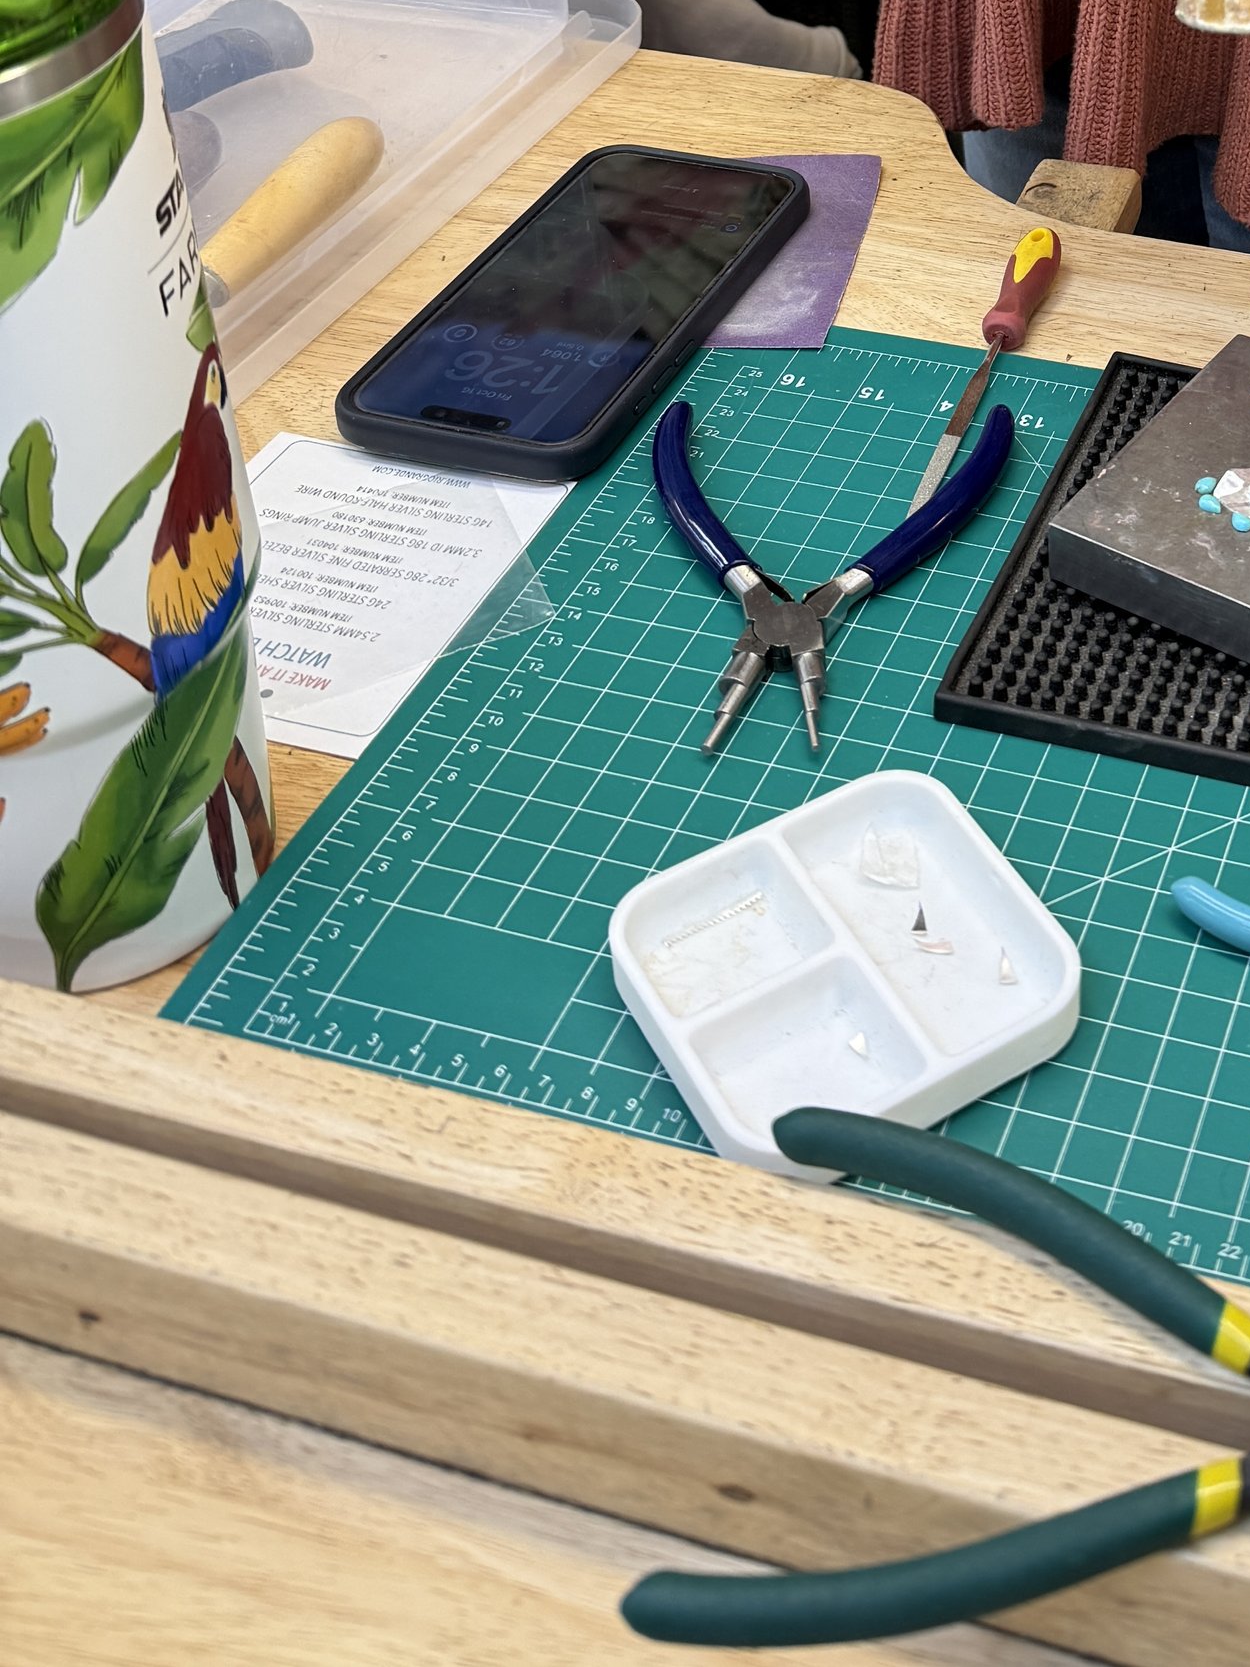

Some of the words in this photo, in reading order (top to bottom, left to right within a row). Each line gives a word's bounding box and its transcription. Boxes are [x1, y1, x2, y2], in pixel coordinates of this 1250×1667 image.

[444, 350, 563, 395] 1:26
[748, 370, 763, 378] 25
[734, 389, 749, 397] 24
[780, 374, 806, 388] 16
[858, 387, 885, 401] 15
[1019, 414, 1045, 429] 13
[719, 408, 735, 417] 23
[704, 429, 720, 437] 22
[690, 449, 704, 458] 21
[372, 465, 471, 489] WWW.RIOGRANDE.COM
[294, 484, 323, 496] WIRE
[259, 508, 294, 521] RINGS
[388, 501, 424, 517] SILVER
[292, 515, 325, 530] JUMP
[423, 509, 473, 525] STERLING
[641, 516, 655, 524] 18
[323, 521, 360, 535] SILVER
[367, 518, 406, 532] NUMBER:
[473, 519, 493, 528] 14G
[406, 525, 428, 536] ITEM
[359, 528, 408, 546] STERLING
[407, 537, 429, 549] 18G
[622, 538, 637, 547] 17
[291, 547, 328, 563] SILVER
[342, 546, 382, 560] NUMBER:
[382, 554, 403, 564] ITEM
[326, 554, 353, 568] FINE
[604, 562, 619, 571] 16
[280, 567, 313, 578] 100124
[352, 561, 405, 579] SERRATED
[317, 573, 357, 589] NUMBER:
[403, 571, 429, 583] 28G
[280, 579, 318, 596] SILVER
[356, 583, 379, 593] ITEM
[586, 586, 601, 595] 15
[316, 587, 368, 606] STERLING
[366, 598, 392, 610] 24G
[290, 603, 331, 618] NUMBER:
[567, 611, 582, 620] 14
[282, 614, 334, 633] STERLING
[330, 613, 353, 622] ITEM
[548, 636, 563, 646] 13
[258, 640, 332, 669] WATCH
[528, 662, 544, 673] 12
[269, 669, 288, 682] IT
[285, 671, 332, 691] MAKE
[509, 688, 523, 698] 11
[488, 715, 504, 726] 10
[469, 743, 479, 753] 9
[447, 771, 457, 781] 8
[425, 800, 436, 810] 7
[402, 830, 413, 841] 6
[378, 861, 390, 872] 5
[354, 894, 365, 905] 4
[328, 927, 340, 939] 3
[302, 963, 316, 976] 2
[279, 1001, 288, 1013] 1
[324, 1023, 338, 1036] 2
[366, 1032, 380, 1046] 3
[409, 1044, 422, 1055] 4
[451, 1054, 465, 1067] 5
[493, 1064, 508, 1078] 6
[538, 1074, 552, 1087] 7
[580, 1086, 595, 1100] 8
[624, 1098, 639, 1111] 9
[662, 1107, 683, 1122] 10
[1168, 1231, 1192, 1247] 21
[1217, 1243, 1243, 1260] 22
